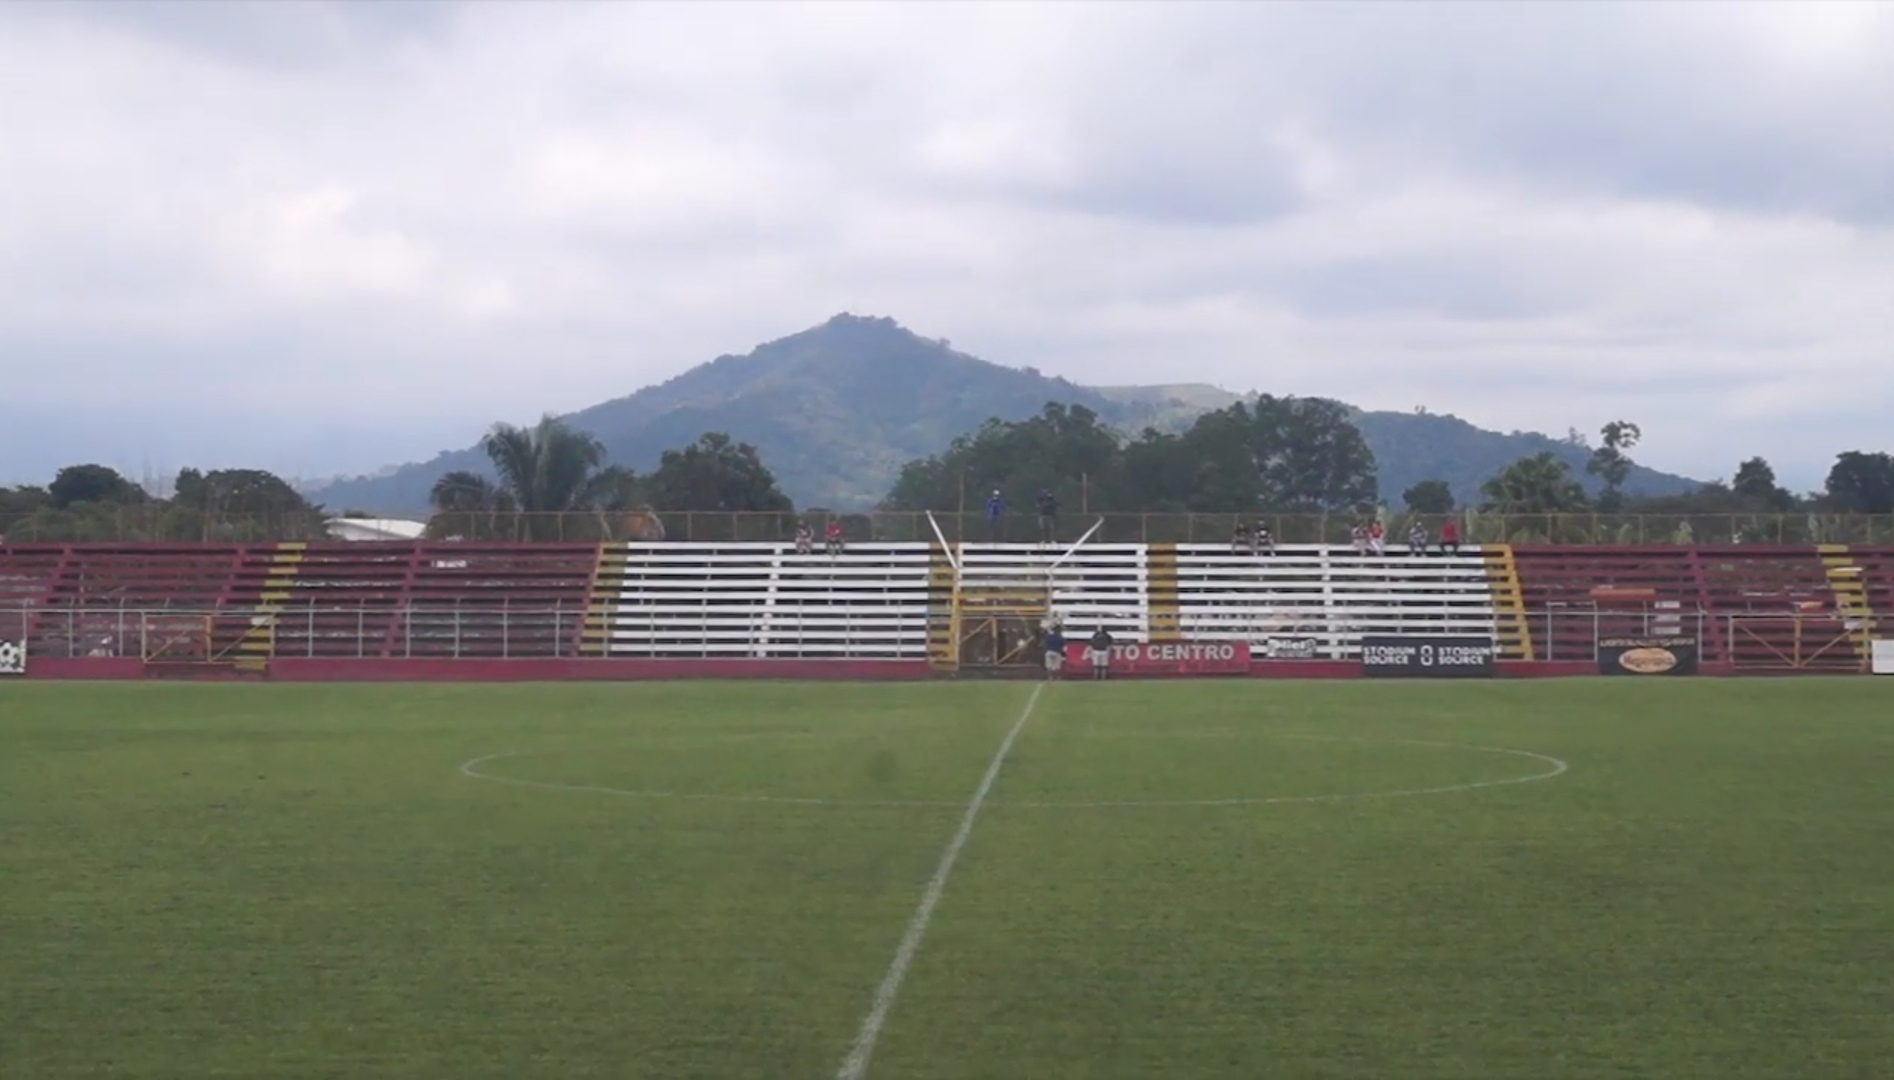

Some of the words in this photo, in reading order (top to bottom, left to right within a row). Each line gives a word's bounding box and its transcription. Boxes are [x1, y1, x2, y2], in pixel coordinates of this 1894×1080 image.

[1082, 644, 1140, 660] ATO
[1147, 644, 1234, 660] CENTRO
[1363, 656, 1409, 665] SOURCE
[1438, 656, 1484, 665] SOURCE
